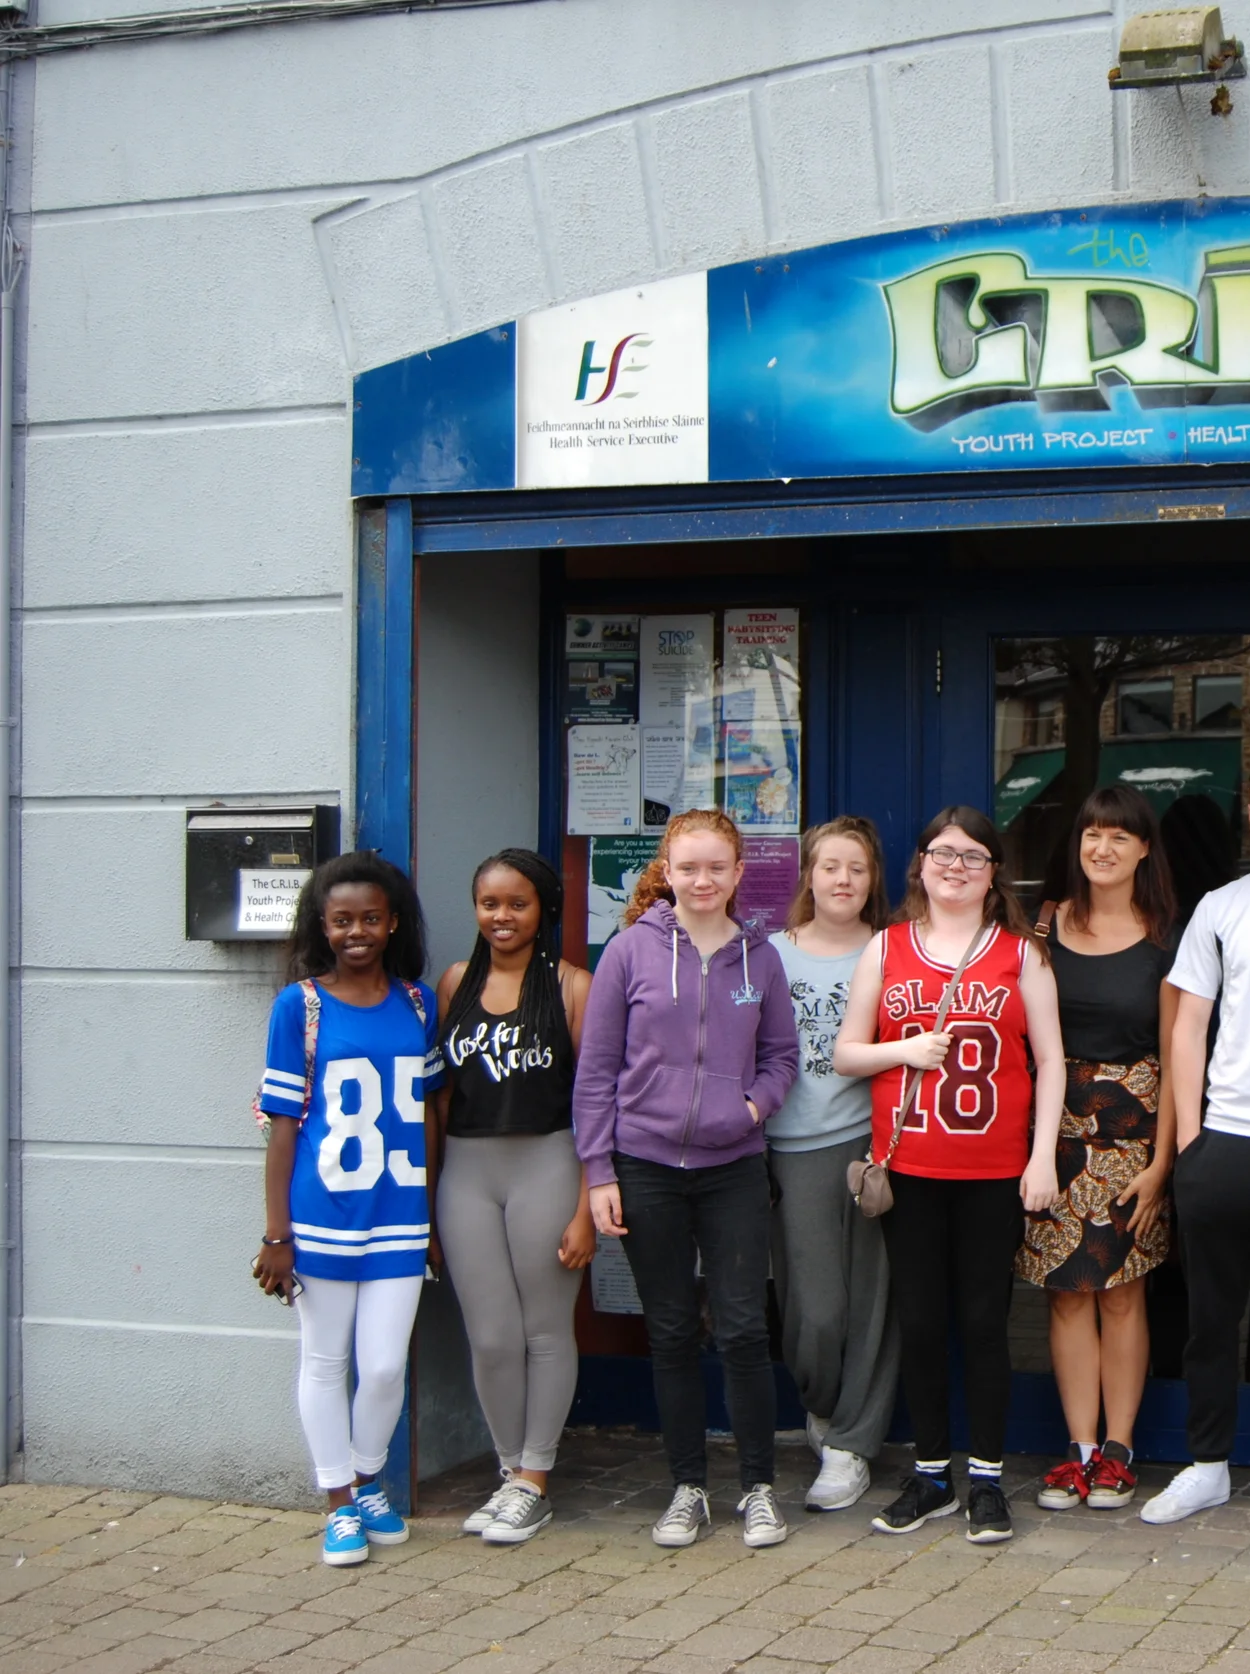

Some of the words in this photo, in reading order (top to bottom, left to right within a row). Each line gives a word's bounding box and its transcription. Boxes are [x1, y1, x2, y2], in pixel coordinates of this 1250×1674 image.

[527, 418, 605, 433] Feidhmeannacht
[608, 420, 621, 430] na
[671, 414, 705, 428] Sláinte
[550, 436, 583, 448] Health
[587, 435, 625, 447] Service
[628, 433, 679, 446] Executive
[950, 432, 1033, 453] YOUTH
[1043, 428, 1153, 450] PROJECT
[747, 613, 778, 622] TEEN
[728, 624, 796, 633] BABYSITTING
[658, 629, 695, 646] STOP
[736, 635, 787, 644] TRAINING
[658, 645, 695, 656] SUICIDE
[613, 839, 625, 847] Are
[625, 840, 638, 849] you
[593, 849, 633, 857] experiencing
[624, 858, 640, 866] your
[252, 878, 269, 889] The
[270, 878, 303, 889] C.R.I.B.
[247, 895, 273, 906] Youth
[245, 911, 252, 922] &
[254, 911, 283, 922] Health
[884, 979, 1011, 1021] SLAM
[448, 1022, 489, 1066] Lost
[491, 1021, 524, 1056] for
[481, 1033, 553, 1082] Words
[892, 1021, 1002, 1134] 18
[317, 1056, 427, 1192] 85
